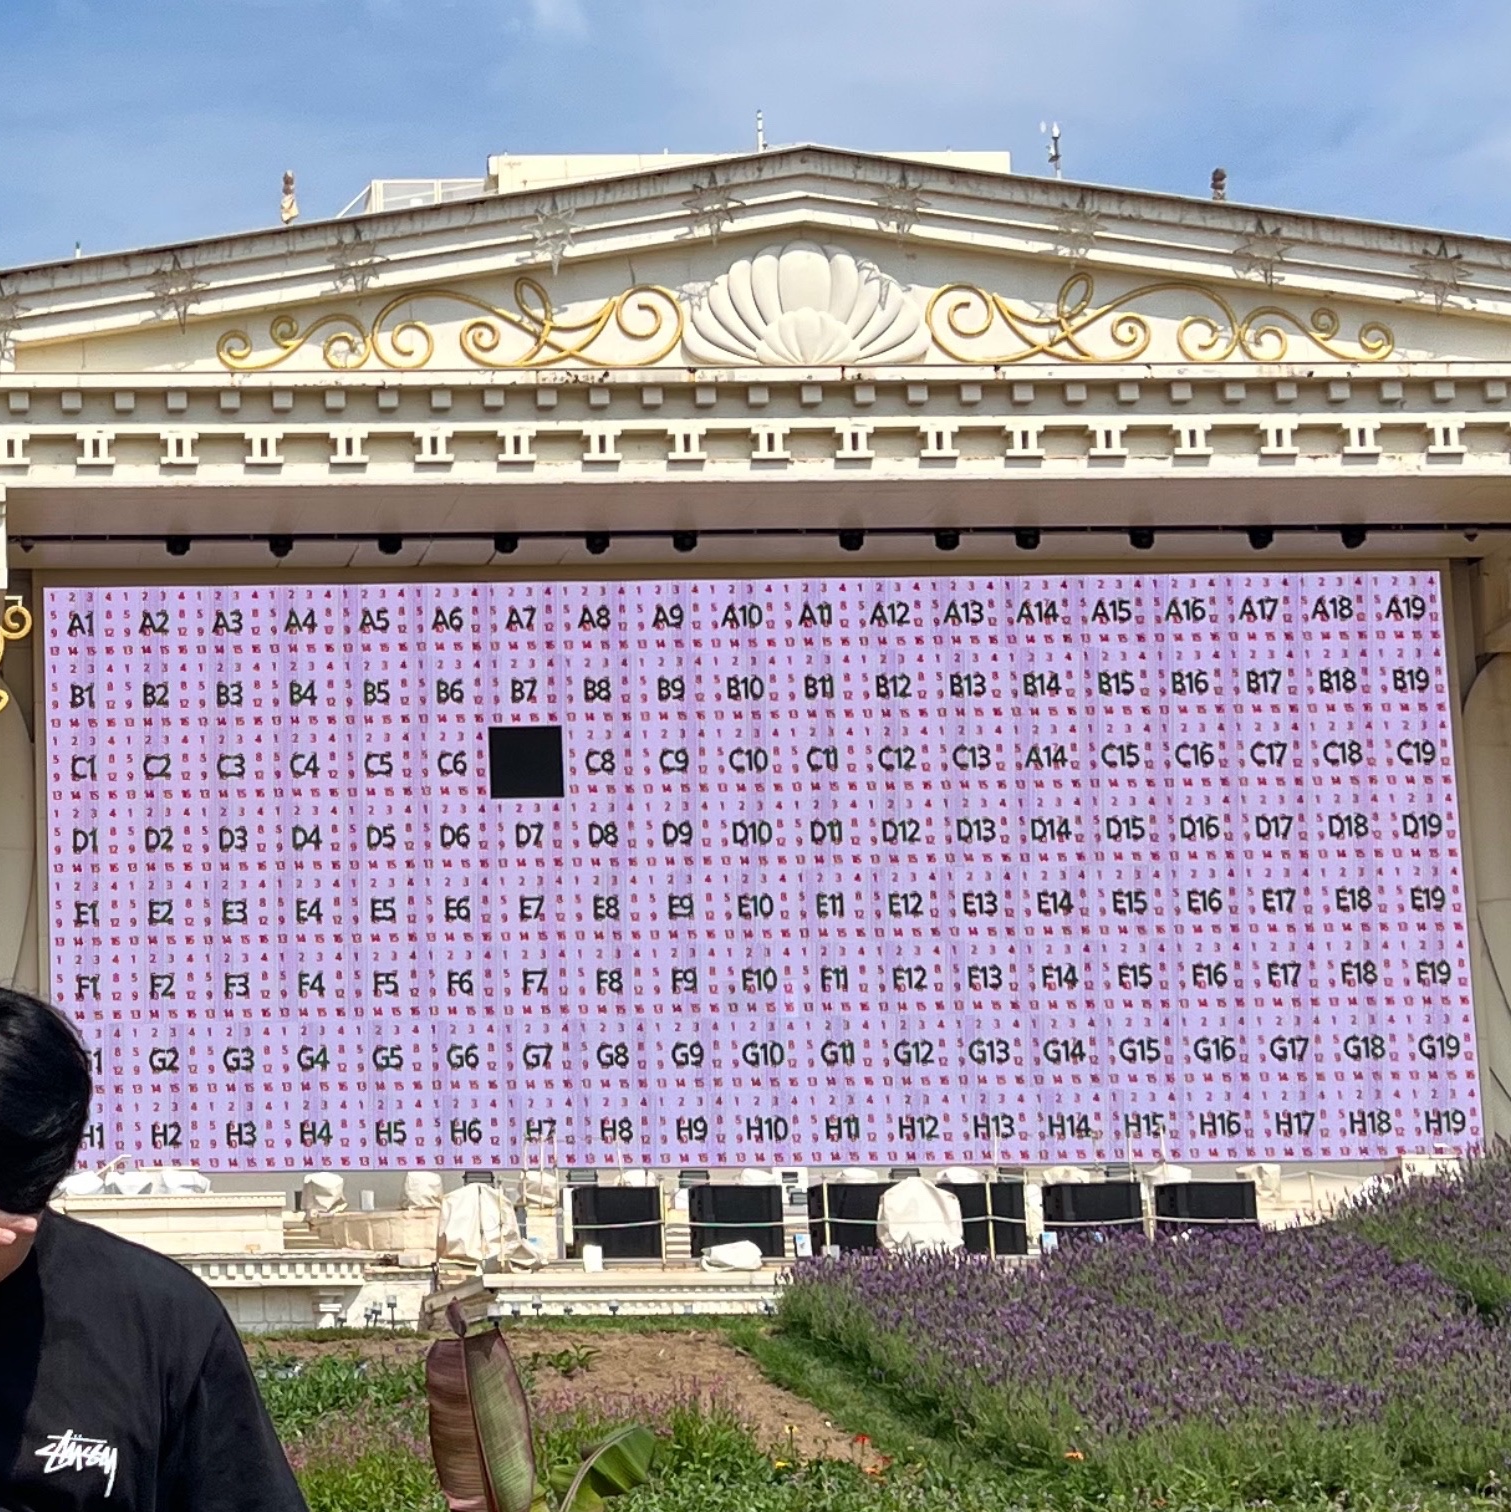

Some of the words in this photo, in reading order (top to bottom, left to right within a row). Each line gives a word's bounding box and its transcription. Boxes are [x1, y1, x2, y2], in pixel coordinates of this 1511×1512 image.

[68, 611, 93, 636] A1
[139, 610, 169, 635] A2
[212, 610, 242, 633] A3
[285, 608, 317, 633] A4
[360, 608, 389, 632] A5
[432, 607, 463, 632] A6
[506, 606, 536, 629] A7
[578, 605, 610, 630] A8
[652, 604, 683, 628] A9
[722, 603, 762, 629] A10
[799, 602, 832, 627] A11
[870, 601, 910, 626] A12
[944, 600, 983, 625] A13
[1017, 600, 1058, 623] A14
[1092, 600, 1131, 623] A15
[1165, 597, 1205, 621] A16
[1239, 597, 1278, 621] A17
[1312, 596, 1353, 621] A18
[1385, 595, 1425, 620] A19
[70, 683, 94, 708] B1
[143, 682, 169, 708] B2
[217, 682, 242, 707] B3
[290, 680, 317, 705] B4
[364, 680, 390, 705] B5
[437, 679, 464, 704] B6
[511, 678, 537, 703] B7
[584, 677, 611, 702] B8
[658, 676, 685, 701] B9
[727, 675, 764, 700] B10
[805, 674, 834, 699] B11
[876, 674, 911, 698] B12
[950, 672, 986, 697] B13
[1024, 672, 1061, 697] B14
[1098, 671, 1134, 695] B15
[1172, 669, 1208, 695] B16
[1247, 669, 1281, 694] B17
[1320, 668, 1356, 693] B18
[1393, 667, 1429, 692] B19
[71, 755, 96, 781] C1
[143, 754, 171, 780] C2
[217, 754, 245, 779] C3
[290, 753, 319, 778] C4
[365, 752, 392, 776] C5
[438, 751, 467, 776] C6
[586, 749, 615, 774] C8
[660, 749, 689, 773] C9
[729, 748, 768, 773] C10
[807, 746, 838, 772] C11
[878, 746, 916, 771] C12
[953, 744, 990, 770] C13
[1025, 746, 1067, 768] A14
[1102, 743, 1139, 768] C15
[1175, 742, 1214, 767] C16
[1251, 742, 1287, 766] C17
[1324, 740, 1362, 766] C18
[1397, 739, 1435, 765] C19
[73, 828, 98, 853] D1
[145, 826, 173, 852] D2
[219, 826, 247, 852] D3
[292, 825, 322, 850] D4
[367, 824, 395, 850] D5
[440, 823, 470, 848] D6
[516, 822, 543, 847] D7
[589, 822, 618, 847] D8
[663, 821, 692, 846] D9
[733, 820, 772, 845] D10
[811, 819, 842, 845] D11
[882, 819, 920, 844] D12
[957, 818, 995, 842] D13
[1031, 818, 1071, 842] D14
[1106, 816, 1144, 841] D15
[1181, 816, 1219, 840] D16
[1256, 814, 1292, 840] D17
[1329, 813, 1368, 838] D18
[1403, 813, 1442, 838] D19
[74, 901, 99, 927] E1
[148, 900, 173, 925] E2
[222, 899, 247, 925] E3
[296, 898, 323, 923] E4
[371, 897, 395, 923] E5
[445, 896, 470, 922] E6
[520, 896, 544, 921] E7
[594, 895, 619, 920] E8
[669, 894, 693, 919] E9
[738, 893, 773, 919] E10
[817, 893, 844, 918] E11
[889, 893, 923, 917] E12
[963, 891, 997, 916] E13
[1038, 890, 1074, 915] E14
[1113, 890, 1147, 915] E15
[1188, 888, 1222, 914] E16
[1263, 888, 1295, 912] E17
[1336, 886, 1372, 912] E18
[1411, 886, 1445, 912] E19
[149, 973, 175, 999] F2
[224, 973, 249, 999] F3
[299, 972, 325, 997] F4
[374, 971, 398, 996] F5
[448, 970, 473, 995] F6
[523, 970, 547, 995] F7
[597, 969, 623, 994] F8
[672, 968, 697, 994] F9
[742, 967, 777, 992] F10
[821, 966, 848, 992] F11
[893, 966, 927, 990] F12
[968, 965, 1002, 990] F13
[1042, 963, 1078, 989] F14
[1118, 963, 1152, 989] F15
[1193, 962, 1227, 987] F16
[1268, 962, 1301, 987] F17
[1342, 960, 1377, 985] F18
[1417, 960, 1451, 985] F19
[149, 1047, 179, 1073] G2
[223, 1046, 254, 1072] G3
[297, 1046, 330, 1071] G4
[373, 1045, 403, 1071] G5
[447, 1044, 479, 1069] G6
[523, 1043, 552, 1069] G7
[597, 1043, 629, 1068] G8
[672, 1041, 704, 1067] G9
[743, 1041, 784, 1067] G10
[821, 1040, 854, 1066] G11
[894, 1039, 934, 1066] G12
[969, 1039, 1009, 1064] G13
[1044, 1040, 1085, 1064] G14
[1120, 1037, 1160, 1063] G15
[1194, 1037, 1235, 1062] G16
[1270, 1036, 1308, 1061] G17
[1344, 1035, 1385, 1060] G18
[1419, 1034, 1459, 1060] G19
[152, 1122, 181, 1148] H2
[226, 1121, 256, 1147] H3
[300, 1120, 332, 1145] H4
[376, 1120, 406, 1145] H5
[451, 1118, 482, 1144] H6
[601, 1117, 633, 1143] H8
[677, 1117, 707, 1141] H9
[747, 1116, 788, 1141] H10
[826, 1115, 859, 1142] H11
[899, 1115, 938, 1141] H12
[974, 1114, 1014, 1139] H13
[1200, 1111, 1240, 1136] H16
[1276, 1111, 1314, 1136] H17
[1350, 1109, 1391, 1135] H18
[1425, 1110, 1465, 1134] H19
